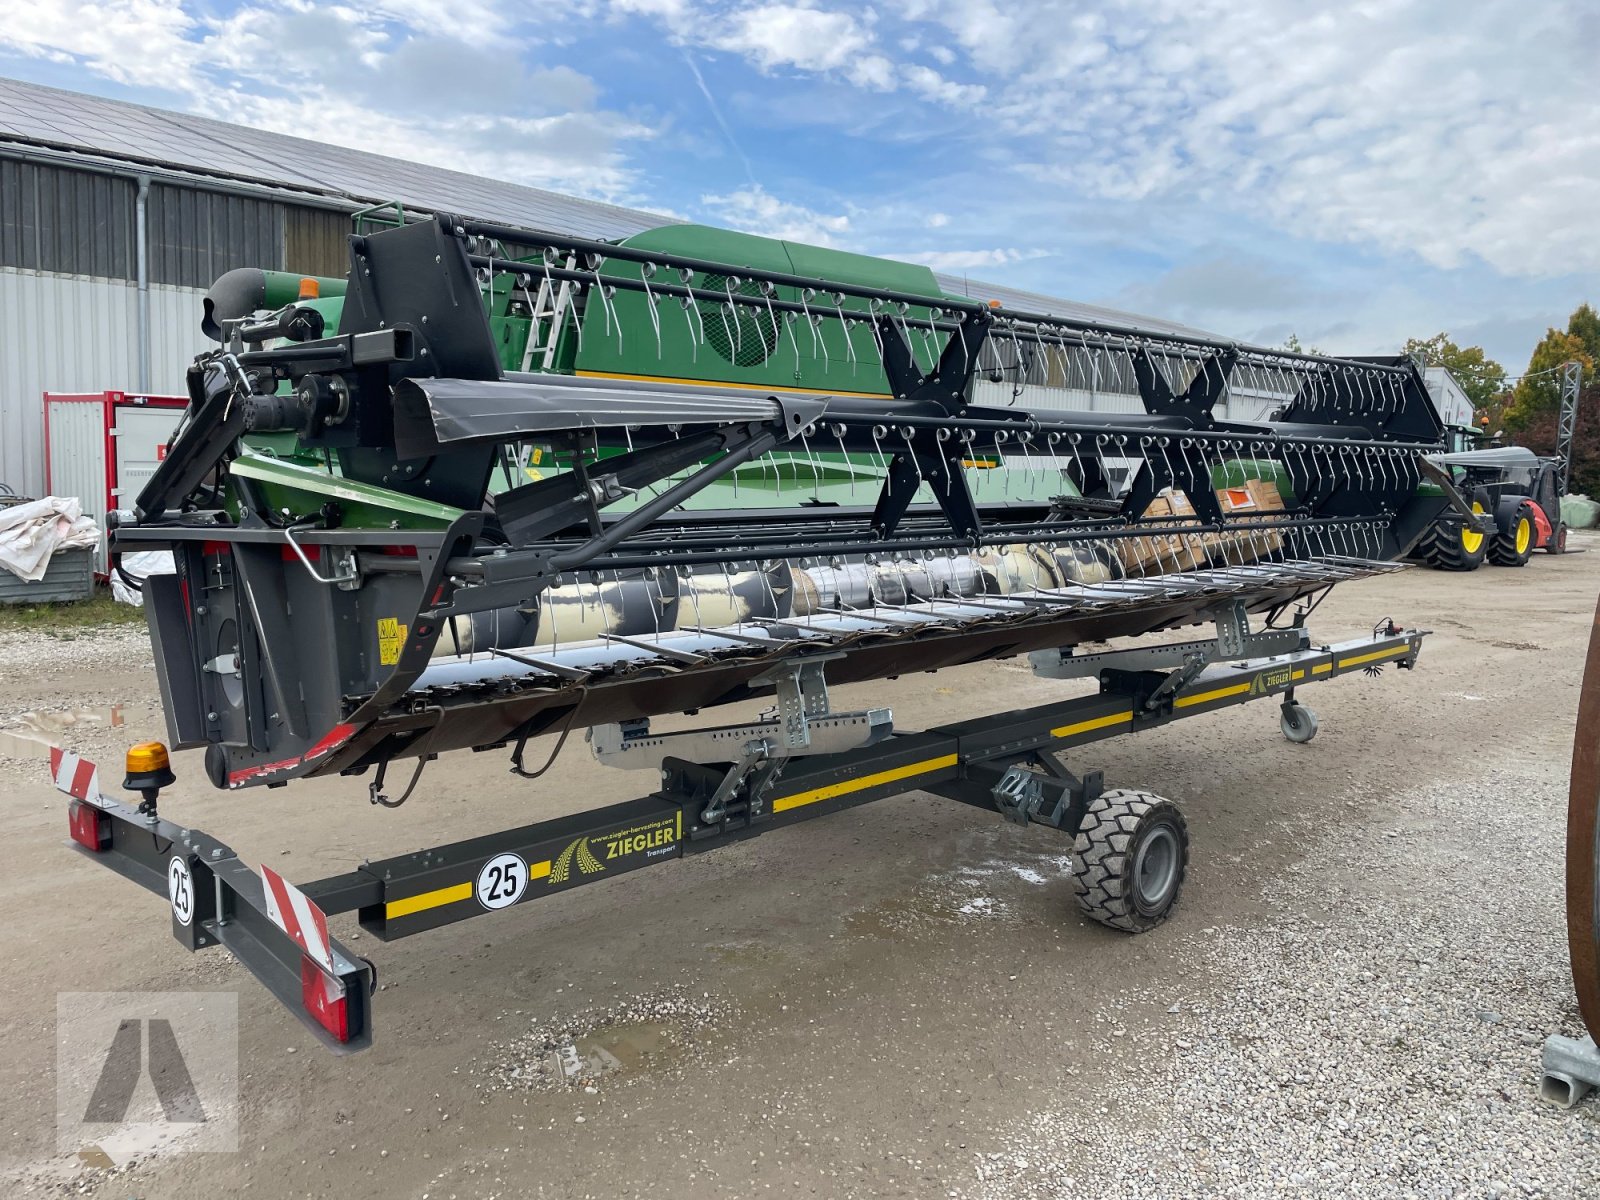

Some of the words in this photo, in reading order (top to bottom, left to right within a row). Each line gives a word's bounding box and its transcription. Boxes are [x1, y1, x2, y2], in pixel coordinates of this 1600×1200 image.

[1267, 673, 1289, 687] ZIEGLER
[590, 817, 674, 844] www.ziegler-harvesting.com
[606, 827, 675, 860] ZIEGLER
[646, 844, 676, 858] Transport
[173, 867, 189, 914] 25
[487, 862, 518, 901] 25
